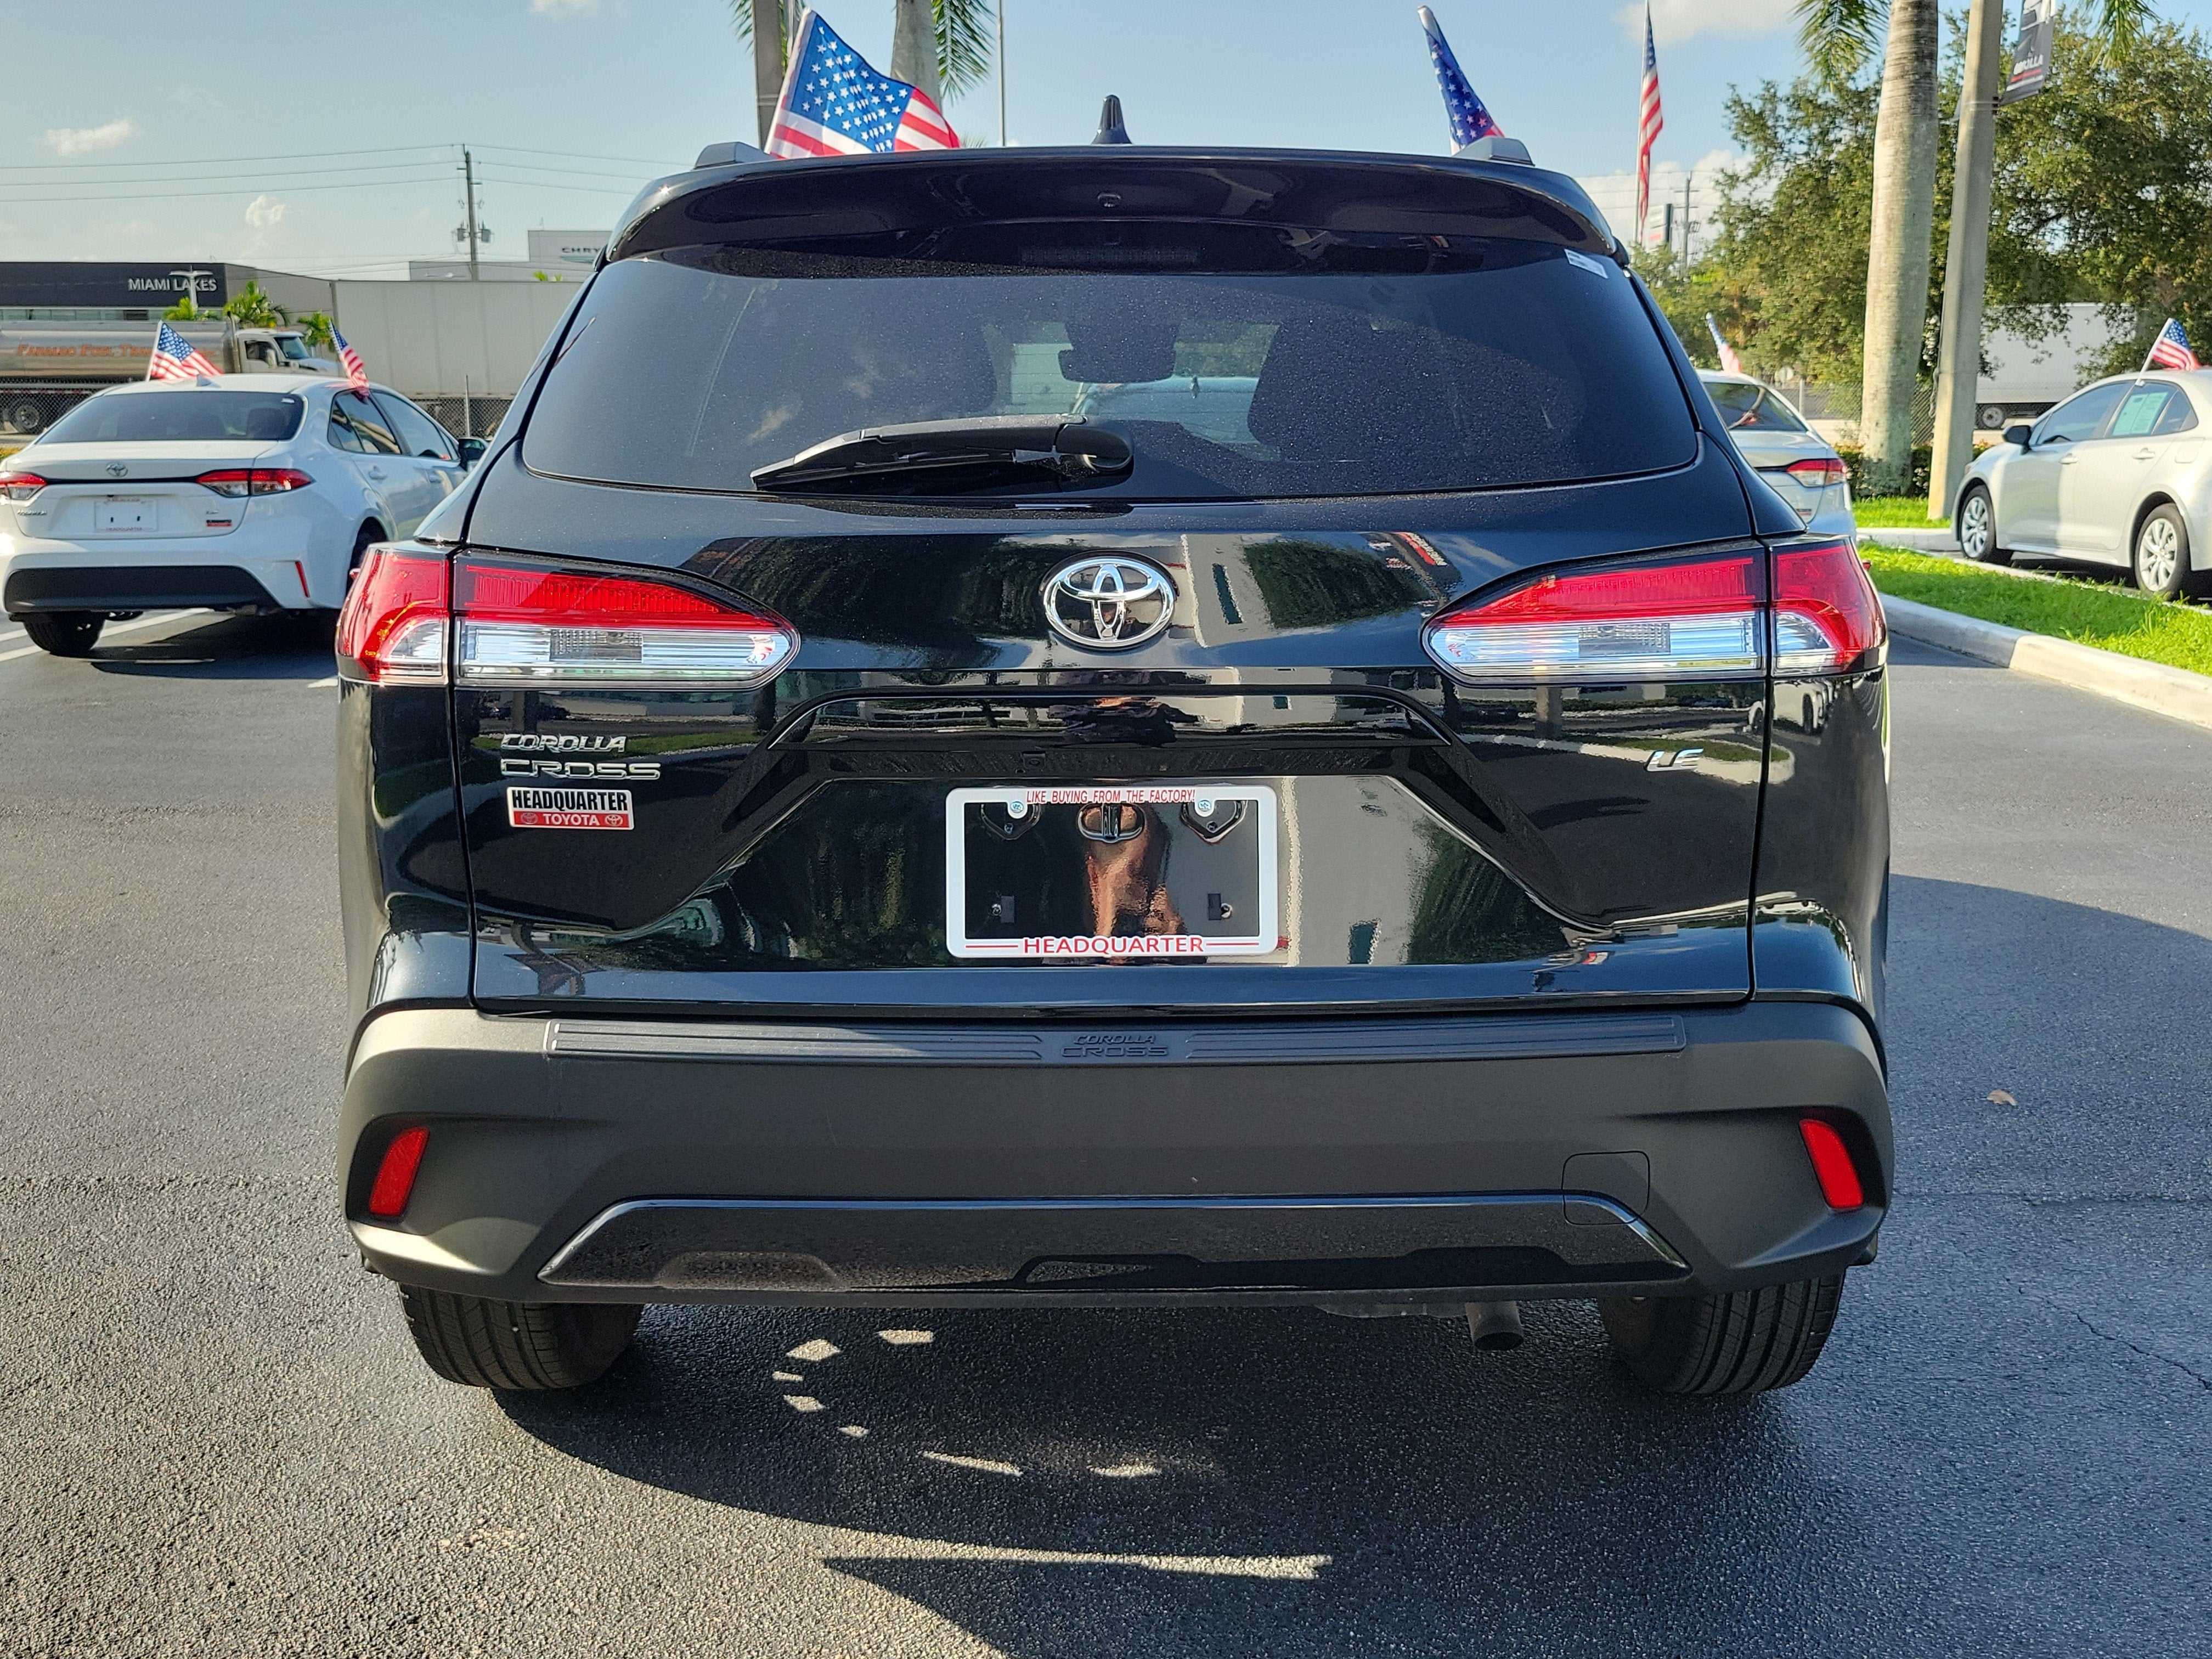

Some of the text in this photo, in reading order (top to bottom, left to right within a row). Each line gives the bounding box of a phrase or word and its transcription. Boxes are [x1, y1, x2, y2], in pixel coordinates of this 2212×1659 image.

[128, 278, 217, 291] MIAMI LAKES
[500, 733, 627, 753] COROLLA
[1643, 747, 1704, 772] LE
[500, 759, 661, 780] CROSS
[511, 789, 628, 811] HEADQUARTER
[1026, 789, 1196, 803] LIKE BUYING FROM THE FACTORY!
[542, 813, 600, 826] TOYOTA
[1024, 937, 1204, 955] HEADQUARTER
[1073, 1035, 1156, 1045] COROLLA
[1061, 1046, 1169, 1058] CROSS
